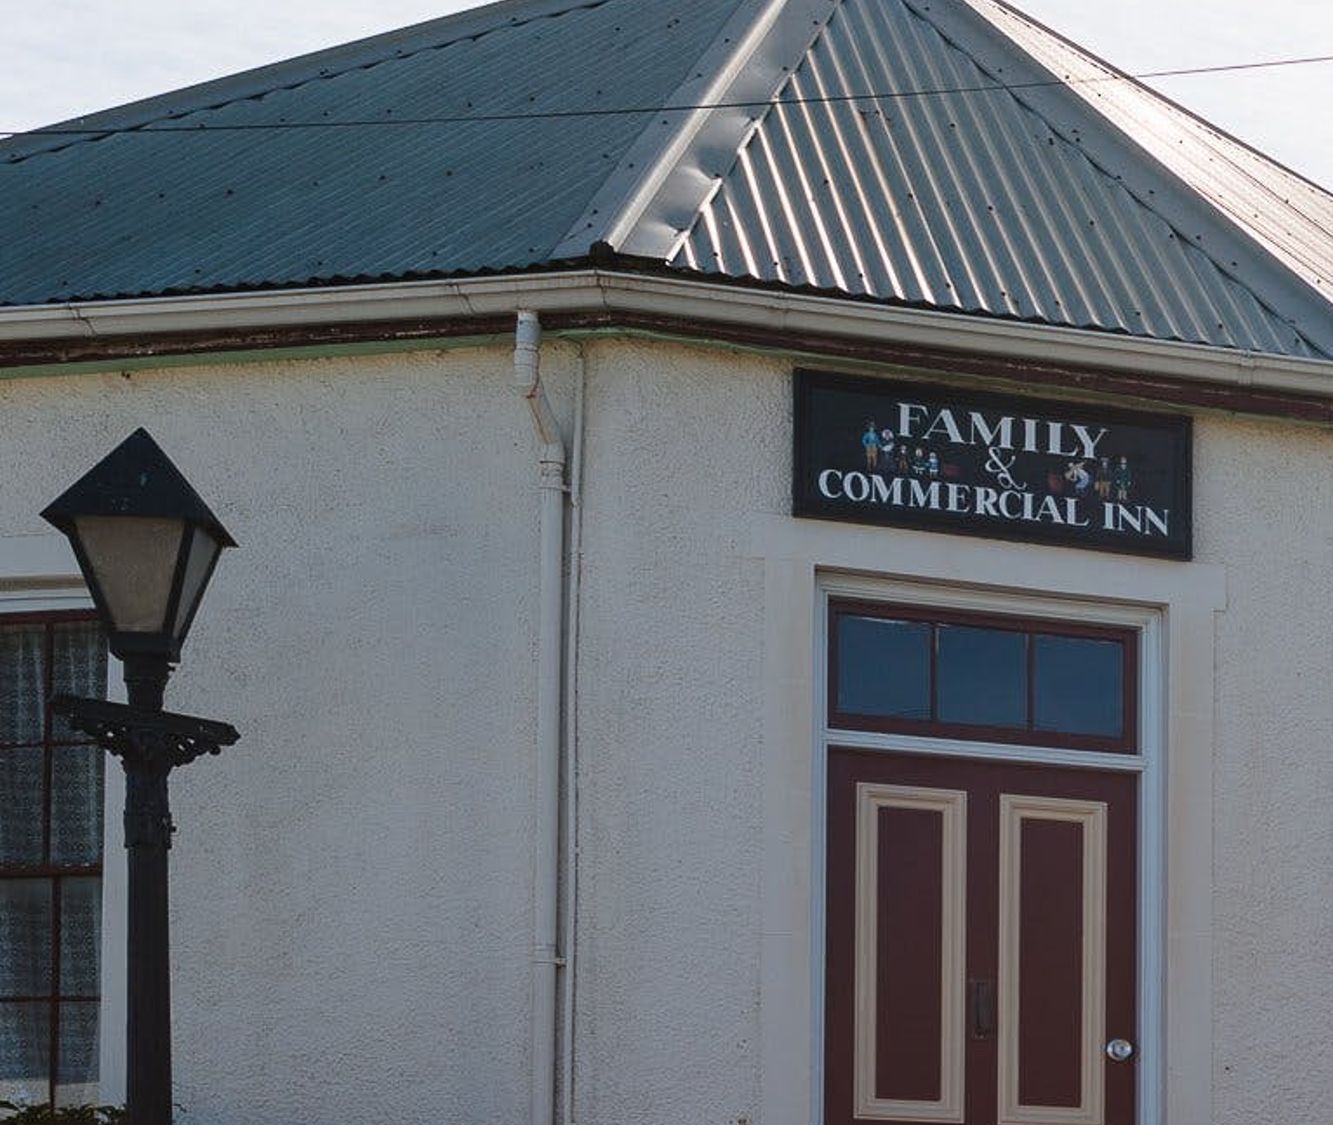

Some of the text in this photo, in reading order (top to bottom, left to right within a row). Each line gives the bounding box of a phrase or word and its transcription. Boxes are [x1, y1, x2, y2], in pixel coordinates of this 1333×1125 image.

[897, 402, 1108, 459] FAMILY
[984, 446, 1028, 491] &
[817, 468, 1170, 537] COMMERCIAL INN
